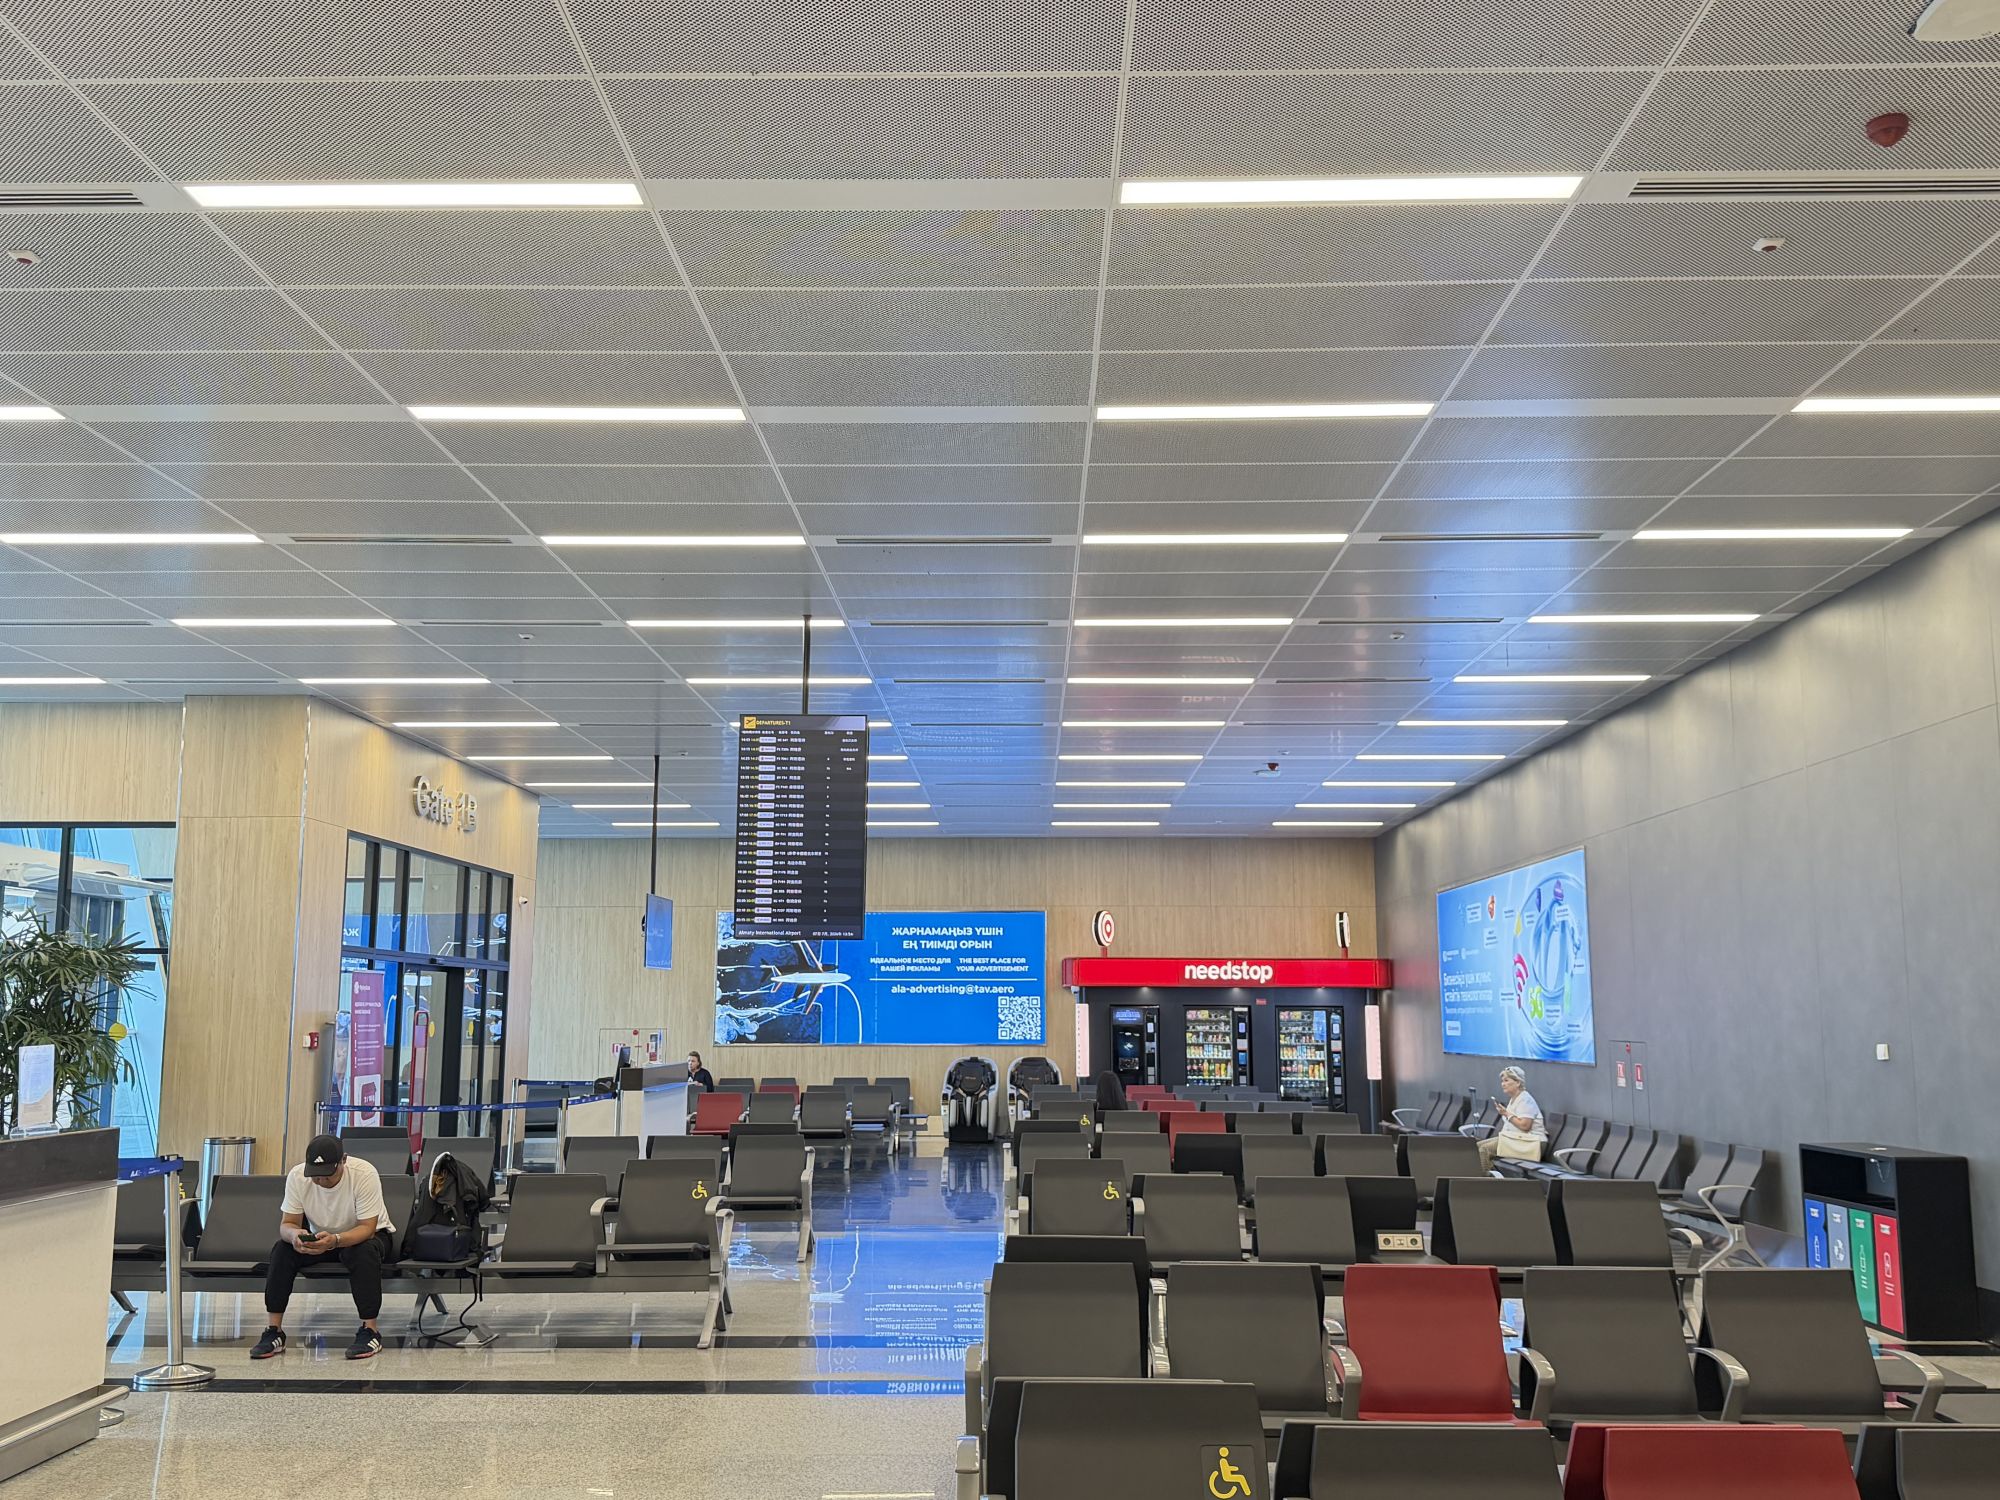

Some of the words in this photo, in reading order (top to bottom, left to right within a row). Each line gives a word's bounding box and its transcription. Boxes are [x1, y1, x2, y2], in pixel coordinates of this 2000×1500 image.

[413, 776, 453, 825] Gate
[892, 927, 973, 937] ЖАРНАМАҢЫЗ
[903, 940, 918, 950] ЕҢ
[920, 940, 957, 950] ТИІМДІ
[960, 940, 992, 949] ОРЫН
[880, 964, 906, 972] ВАШЕЙ
[1184, 960, 1274, 984] needstop
[891, 983, 1015, 995] ala-advertising@tav.aero
